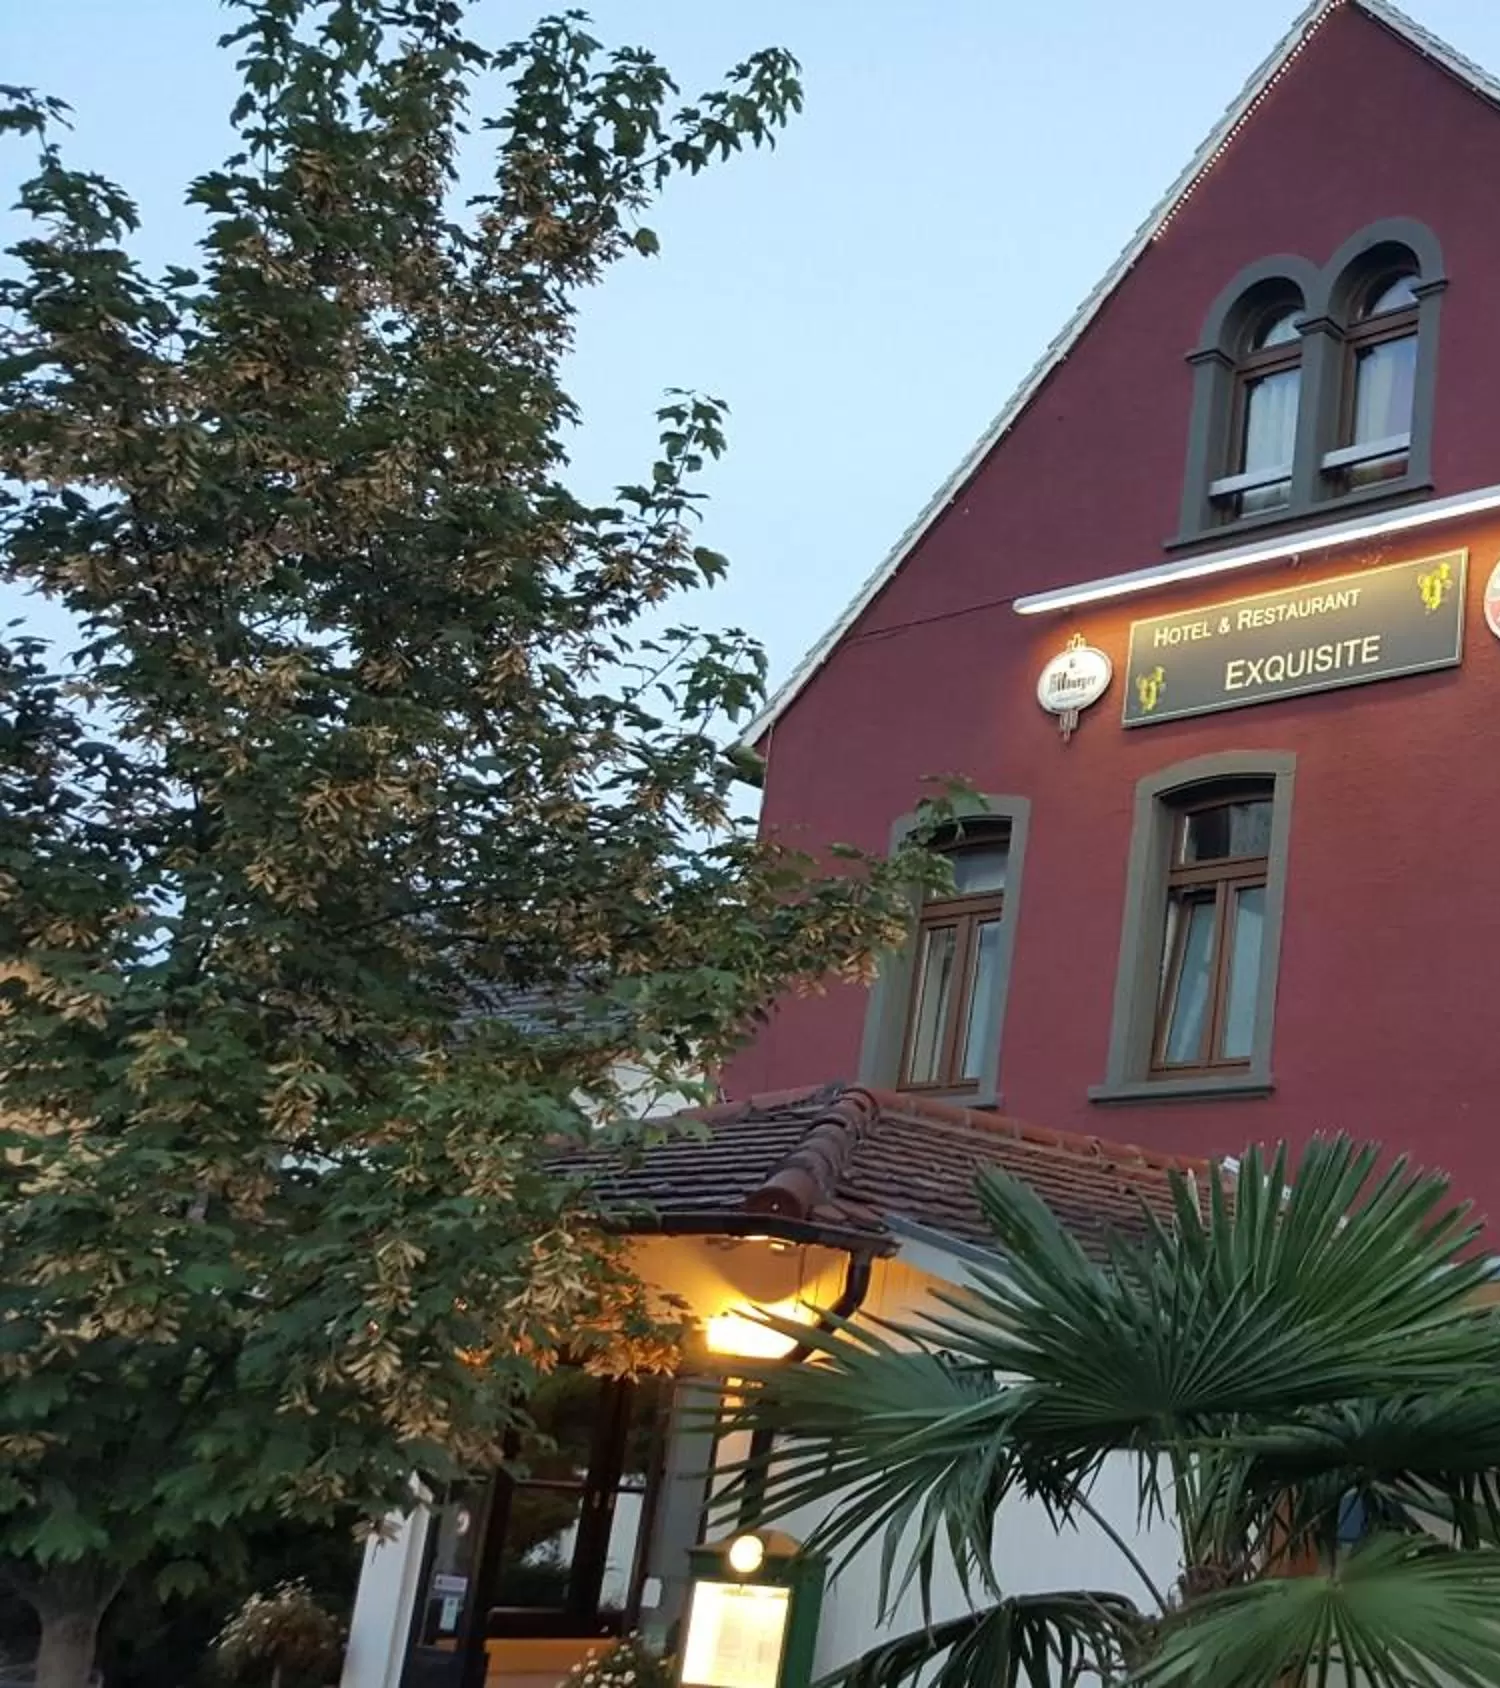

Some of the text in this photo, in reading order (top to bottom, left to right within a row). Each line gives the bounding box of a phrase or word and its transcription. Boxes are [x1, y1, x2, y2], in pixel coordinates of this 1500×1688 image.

[1154, 588, 1362, 648] HOTEL & RESTAURANT
[1224, 634, 1381, 691] EXQUISITE
